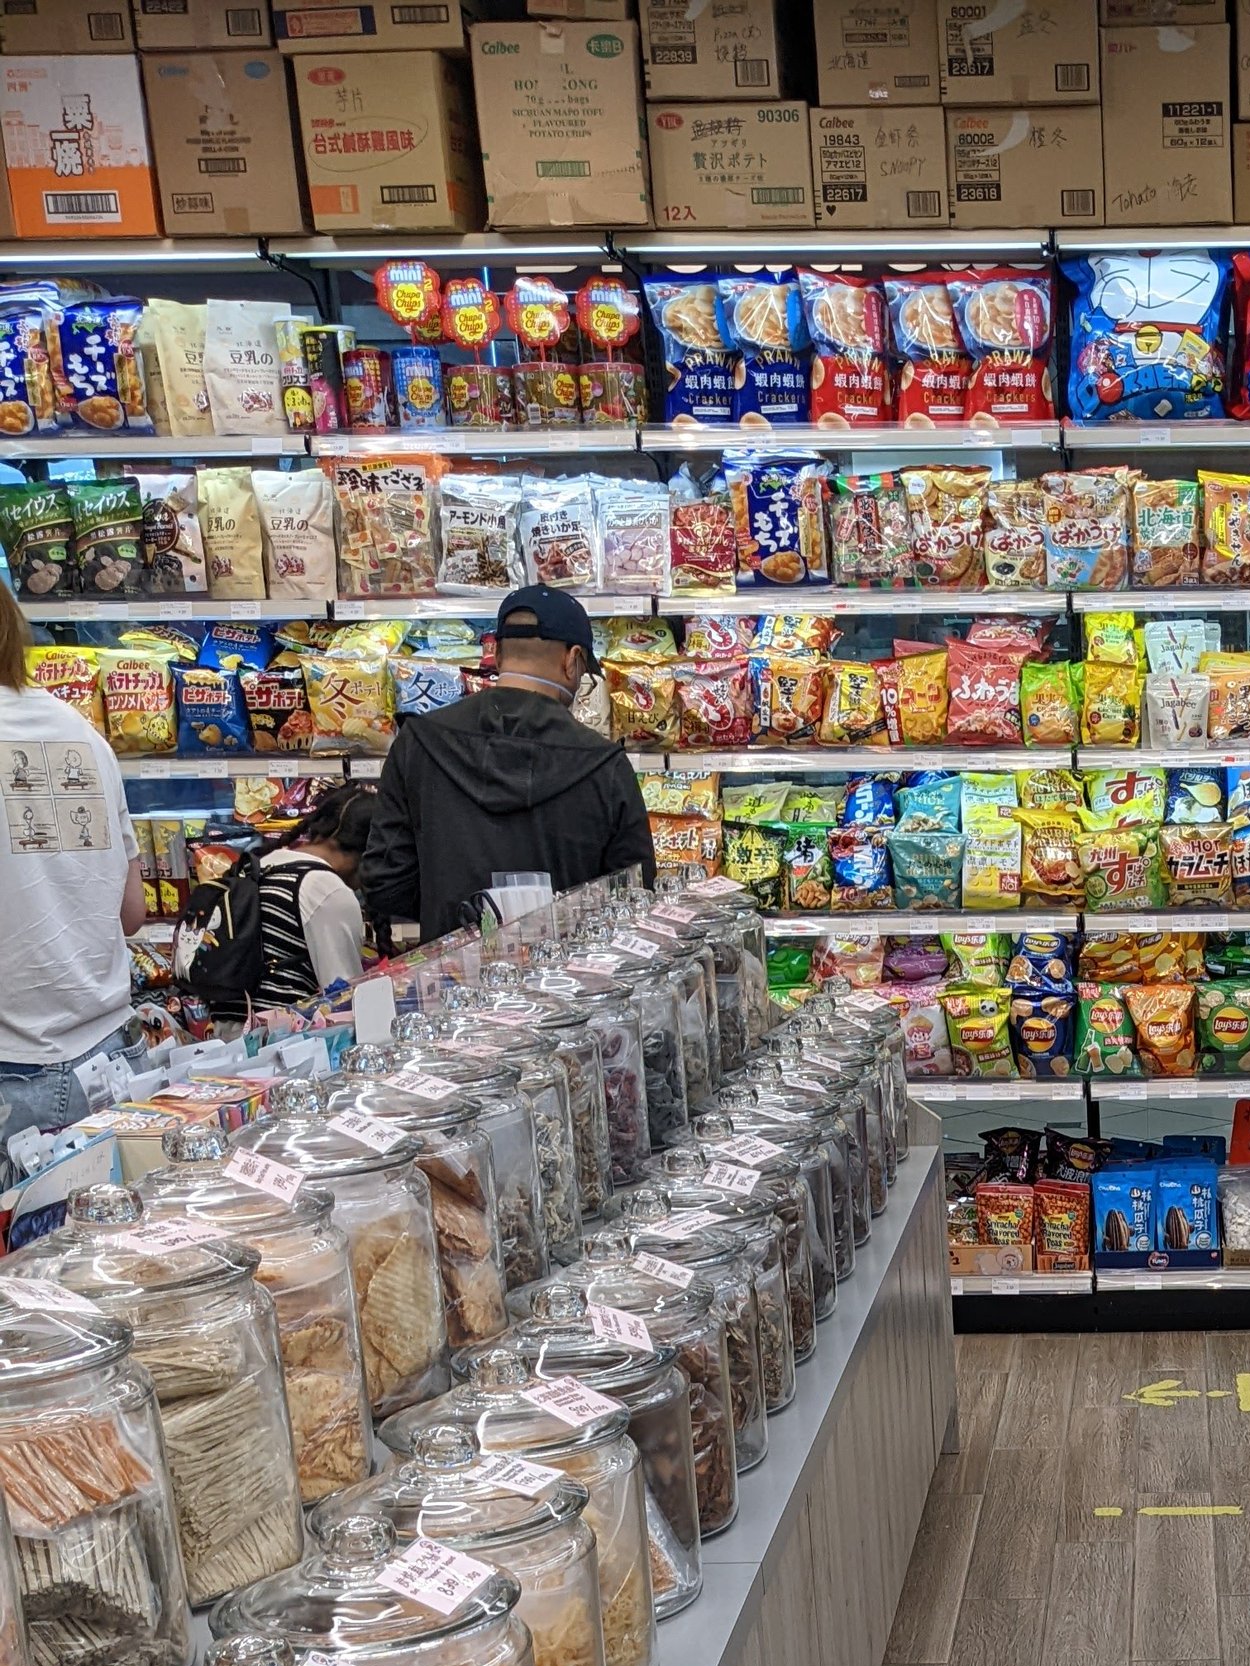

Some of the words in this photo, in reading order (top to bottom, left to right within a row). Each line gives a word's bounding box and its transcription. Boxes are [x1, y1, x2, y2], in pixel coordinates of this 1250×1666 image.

[482, 41, 520, 55] Calbee
[655, 51, 693, 63] 22839
[952, 63, 990, 75] 23617
[512, 108, 552, 118] SICHUAN
[553, 108, 580, 117] MAPO
[581, 107, 603, 117] TOFU
[757, 109, 799, 123] 90306
[1168, 104, 1218, 116] 11221-1
[533, 118, 586, 128] FLAVOURED
[819, 116, 854, 129] Calbee
[953, 117, 988, 129] Calbee
[529, 130, 564, 139] POTATO
[566, 129, 592, 139] CHIPS
[823, 134, 860, 146] 19843
[691, 151, 768, 170] 贅沢ポテト
[826, 188, 863, 201] 22617
[960, 187, 997, 200] 23618
[662, 205, 697, 222] 12入
[389, 266, 422, 282] mini
[395, 289, 421, 301] Chupa
[451, 291, 483, 306] mini
[395, 298, 423, 312] Chups
[458, 312, 484, 324] Chupa
[595, 310, 621, 321] Chupa
[458, 320, 488, 336] Chups
[595, 317, 623, 332] Chups
[230, 349, 274, 367] 豆乳の
[68, 354, 95, 396] もち
[754, 372, 805, 388] 蝦肉蝦餅
[834, 372, 883, 390] 蝦肉蝦餅
[983, 370, 1037, 389] 蝦肉蝦餅
[985, 390, 1036, 405] Crackers
[269, 516, 309, 533] 豆乳の
[1137, 508, 1194, 529] 北海道
[753, 510, 778, 553] もち
[916, 525, 984, 552] ばかうけ
[1052, 520, 1122, 548] ばかうけ
[1160, 643, 1196, 654] Jagabee
[117, 659, 150, 671] Calbee
[107, 671, 164, 692] ポテトチップス
[182, 687, 232, 704] ピザポテト
[245, 685, 306, 710] ピザポテト
[1160, 697, 1197, 709] Jagabee
[627, 712, 659, 724] 甘えび
[1191, 840, 1221, 852] HOT
[1090, 846, 1118, 863] 九州
